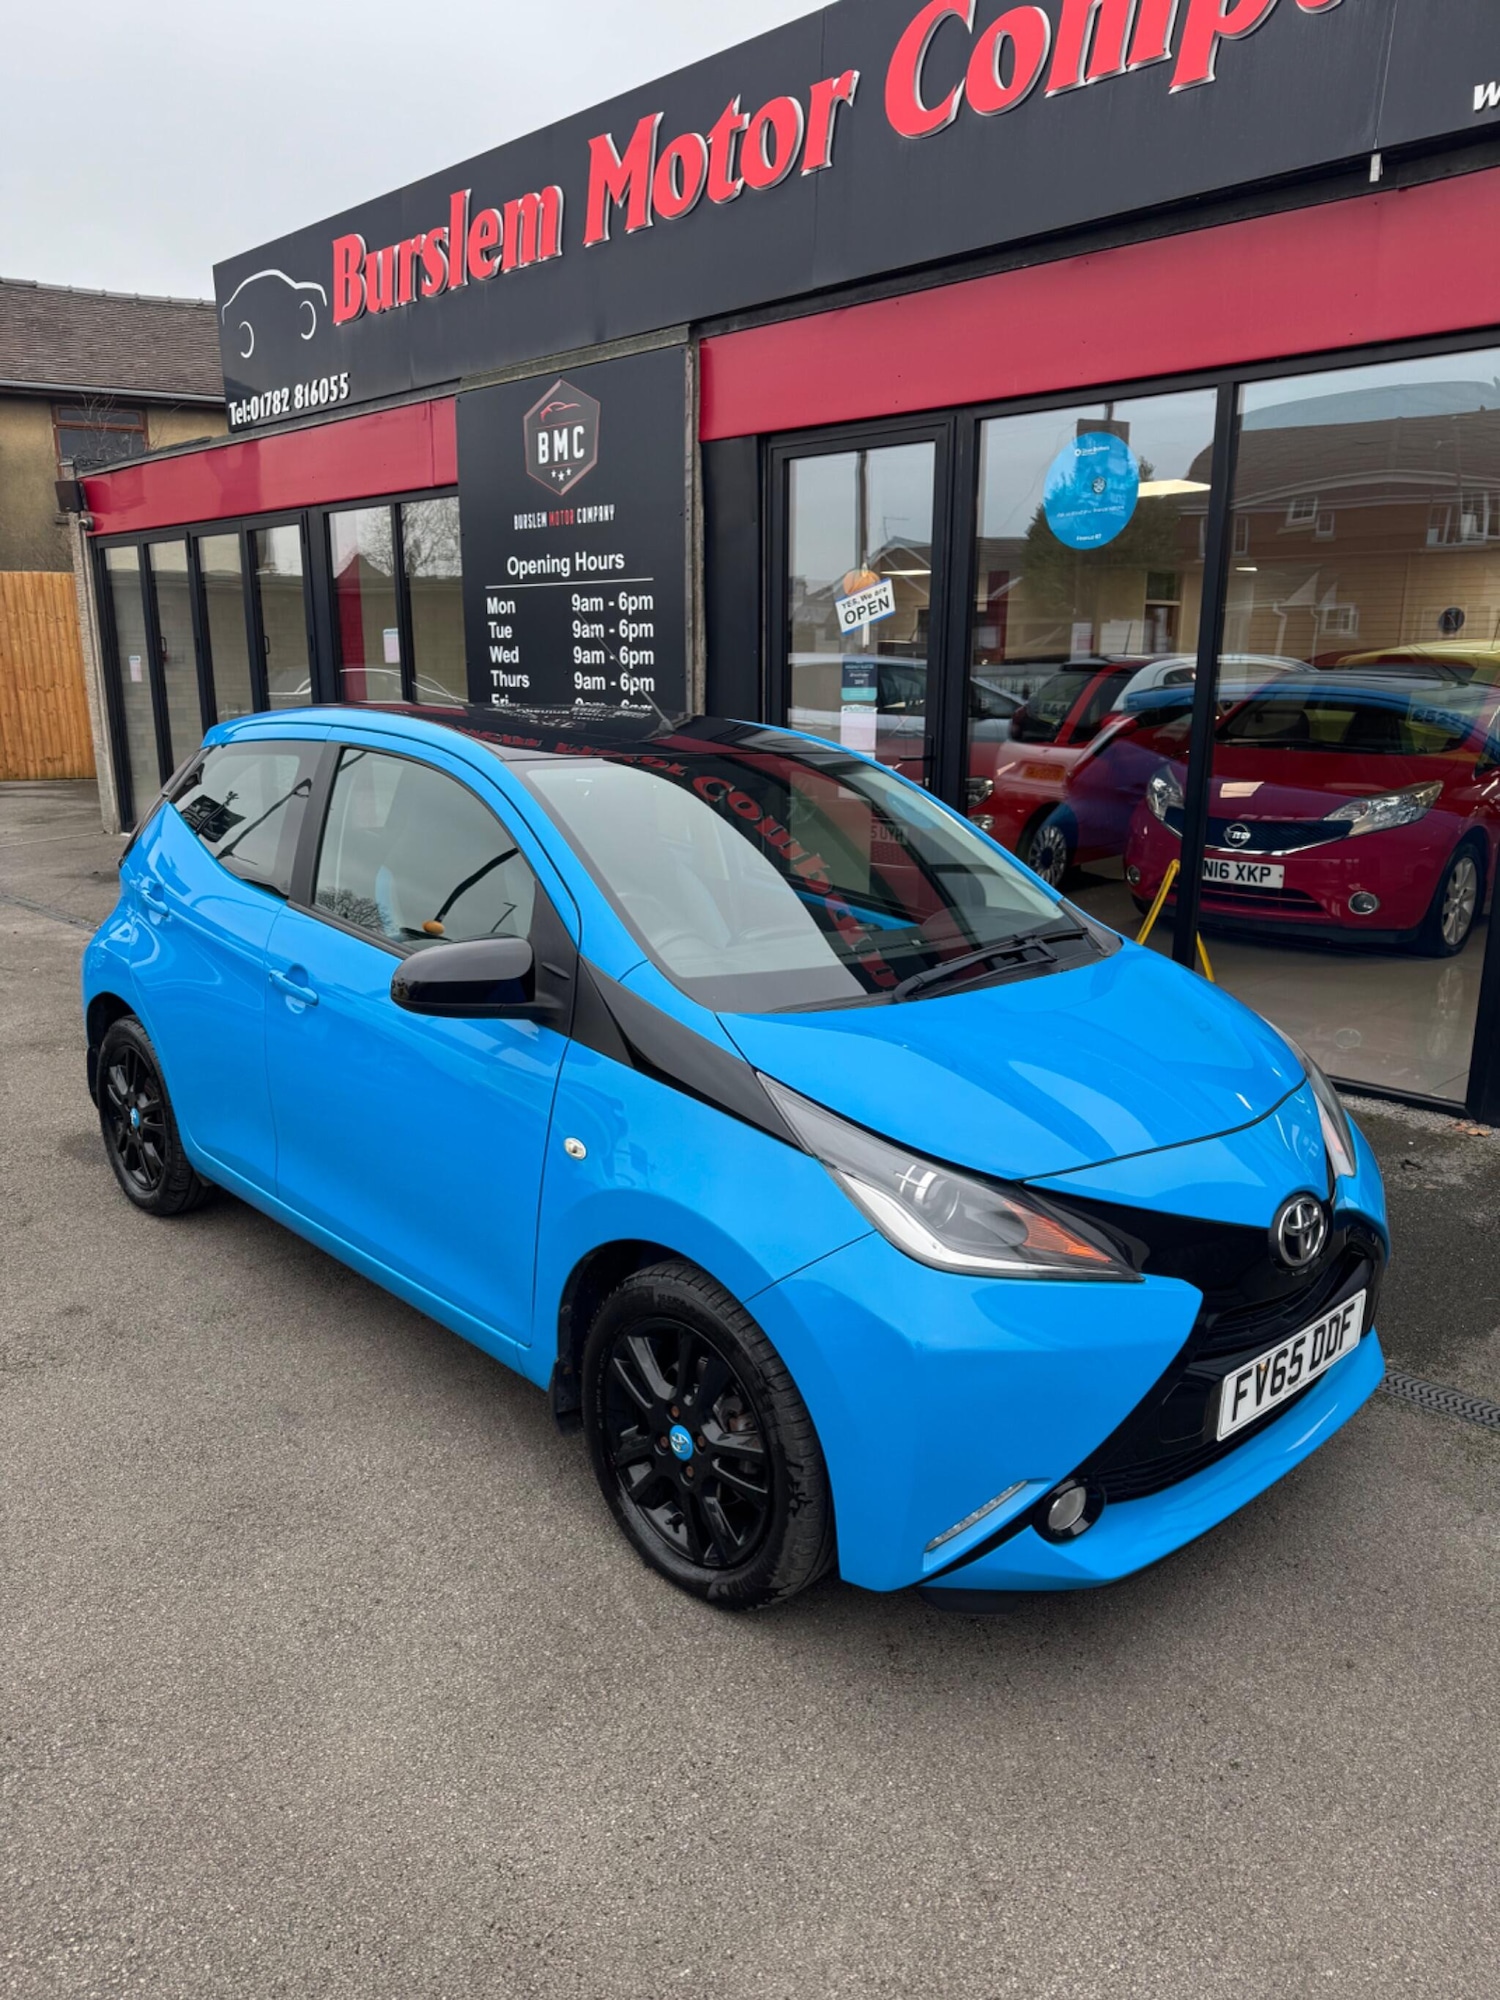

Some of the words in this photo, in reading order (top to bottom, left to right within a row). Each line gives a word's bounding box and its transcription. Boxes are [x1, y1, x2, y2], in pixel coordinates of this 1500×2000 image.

[333, 185, 564, 325] Burslem
[583, 70, 860, 247] Motor
[885, 0, 1343, 139] Comp
[229, 387, 289, 425] Tel:01782
[294, 372, 349, 409] 816055
[537, 425, 585, 464] BMC
[514, 512, 547, 530] BURSLEM
[549, 509, 574, 527] MOTOR
[577, 504, 615, 524] COMPANY
[507, 554, 570, 579] Opening
[575, 551, 625, 571] Hours
[486, 597, 516, 614] Mon
[572, 593, 604, 612] 9am
[618, 591, 653, 615] 6pm
[844, 595, 889, 624] OPEN
[488, 622, 513, 638] Tue
[572, 620, 604, 638] 9am
[619, 619, 654, 642] 6pm
[489, 646, 519, 663] Wed
[573, 645, 605, 664] 9am
[619, 645, 654, 669] 6pm
[490, 669, 530, 687] Thurs
[574, 671, 606, 690] 9am
[620, 672, 655, 696] 6pm
[1235, 864, 1271, 883] XKP
[1232, 1336, 1306, 1422] FV65
[1309, 1302, 1355, 1372] DDF
